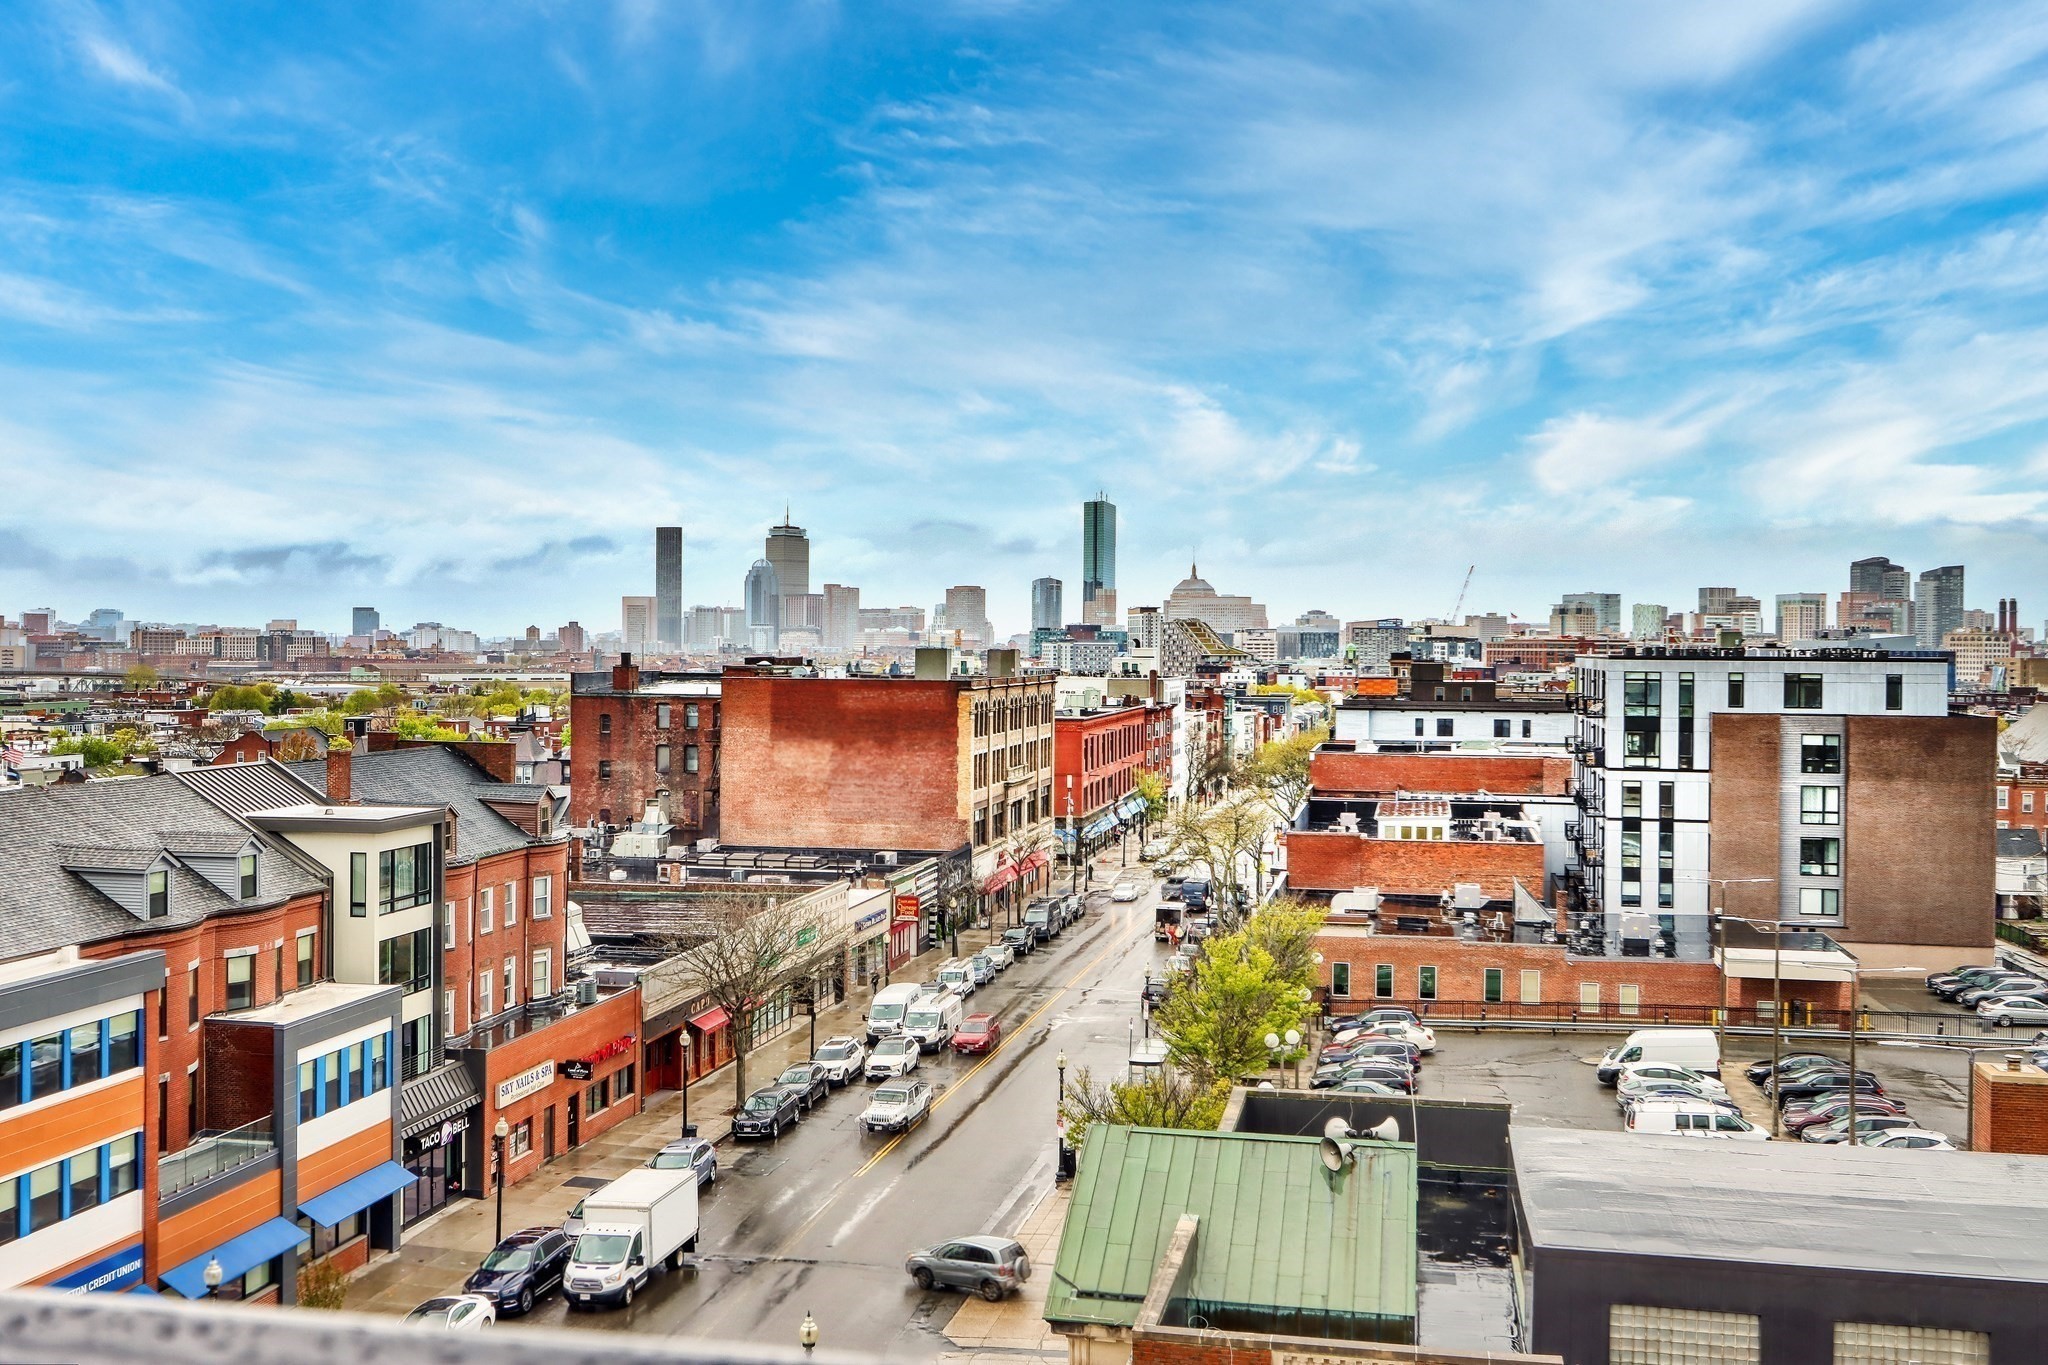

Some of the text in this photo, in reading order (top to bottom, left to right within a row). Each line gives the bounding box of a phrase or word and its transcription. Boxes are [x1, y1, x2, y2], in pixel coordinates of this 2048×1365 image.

[501, 1064, 552, 1097] SKY NAILS & SPA
[421, 1117, 470, 1150] TACO BELL
[88, 1271, 116, 1291] CREDIT
[116, 1258, 142, 1277] UNION
